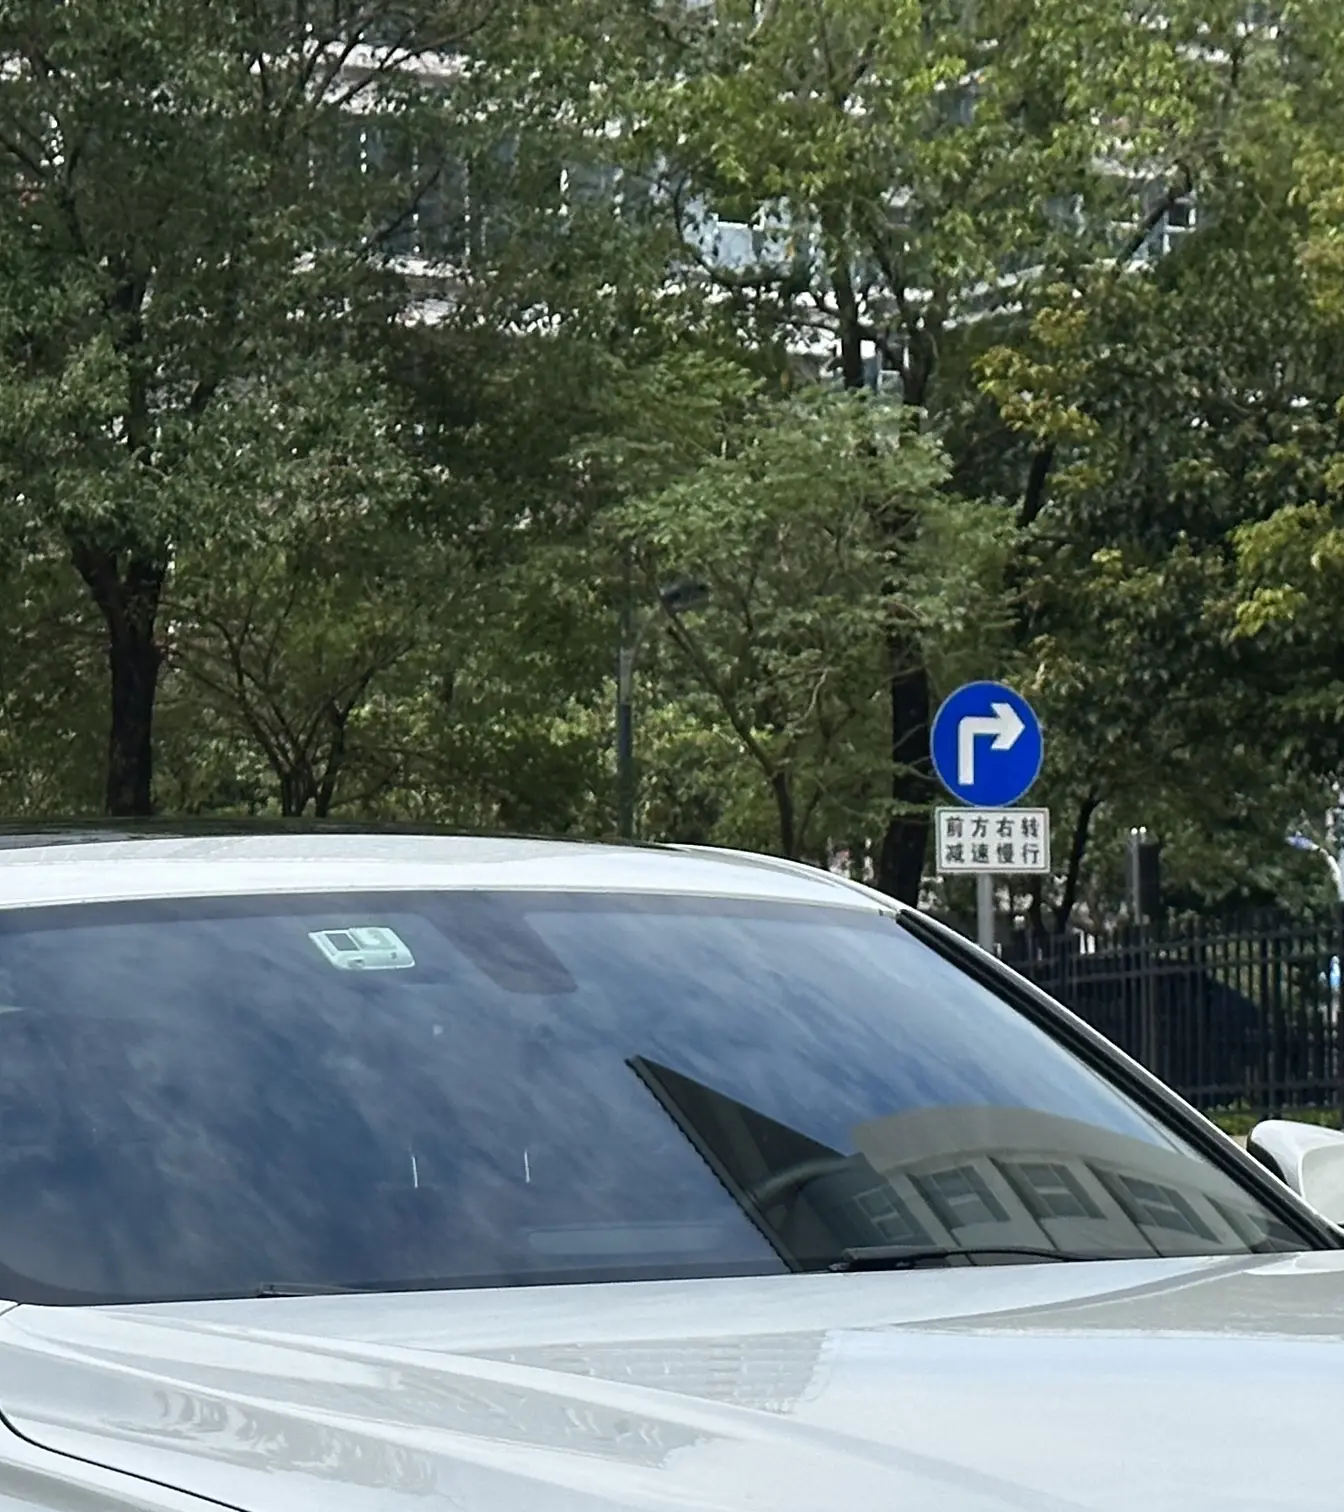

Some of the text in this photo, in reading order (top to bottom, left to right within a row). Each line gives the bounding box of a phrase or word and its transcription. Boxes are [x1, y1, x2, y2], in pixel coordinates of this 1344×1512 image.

[945, 816, 1040, 838] 前方右转
[945, 843, 1040, 864] 减速慢行
